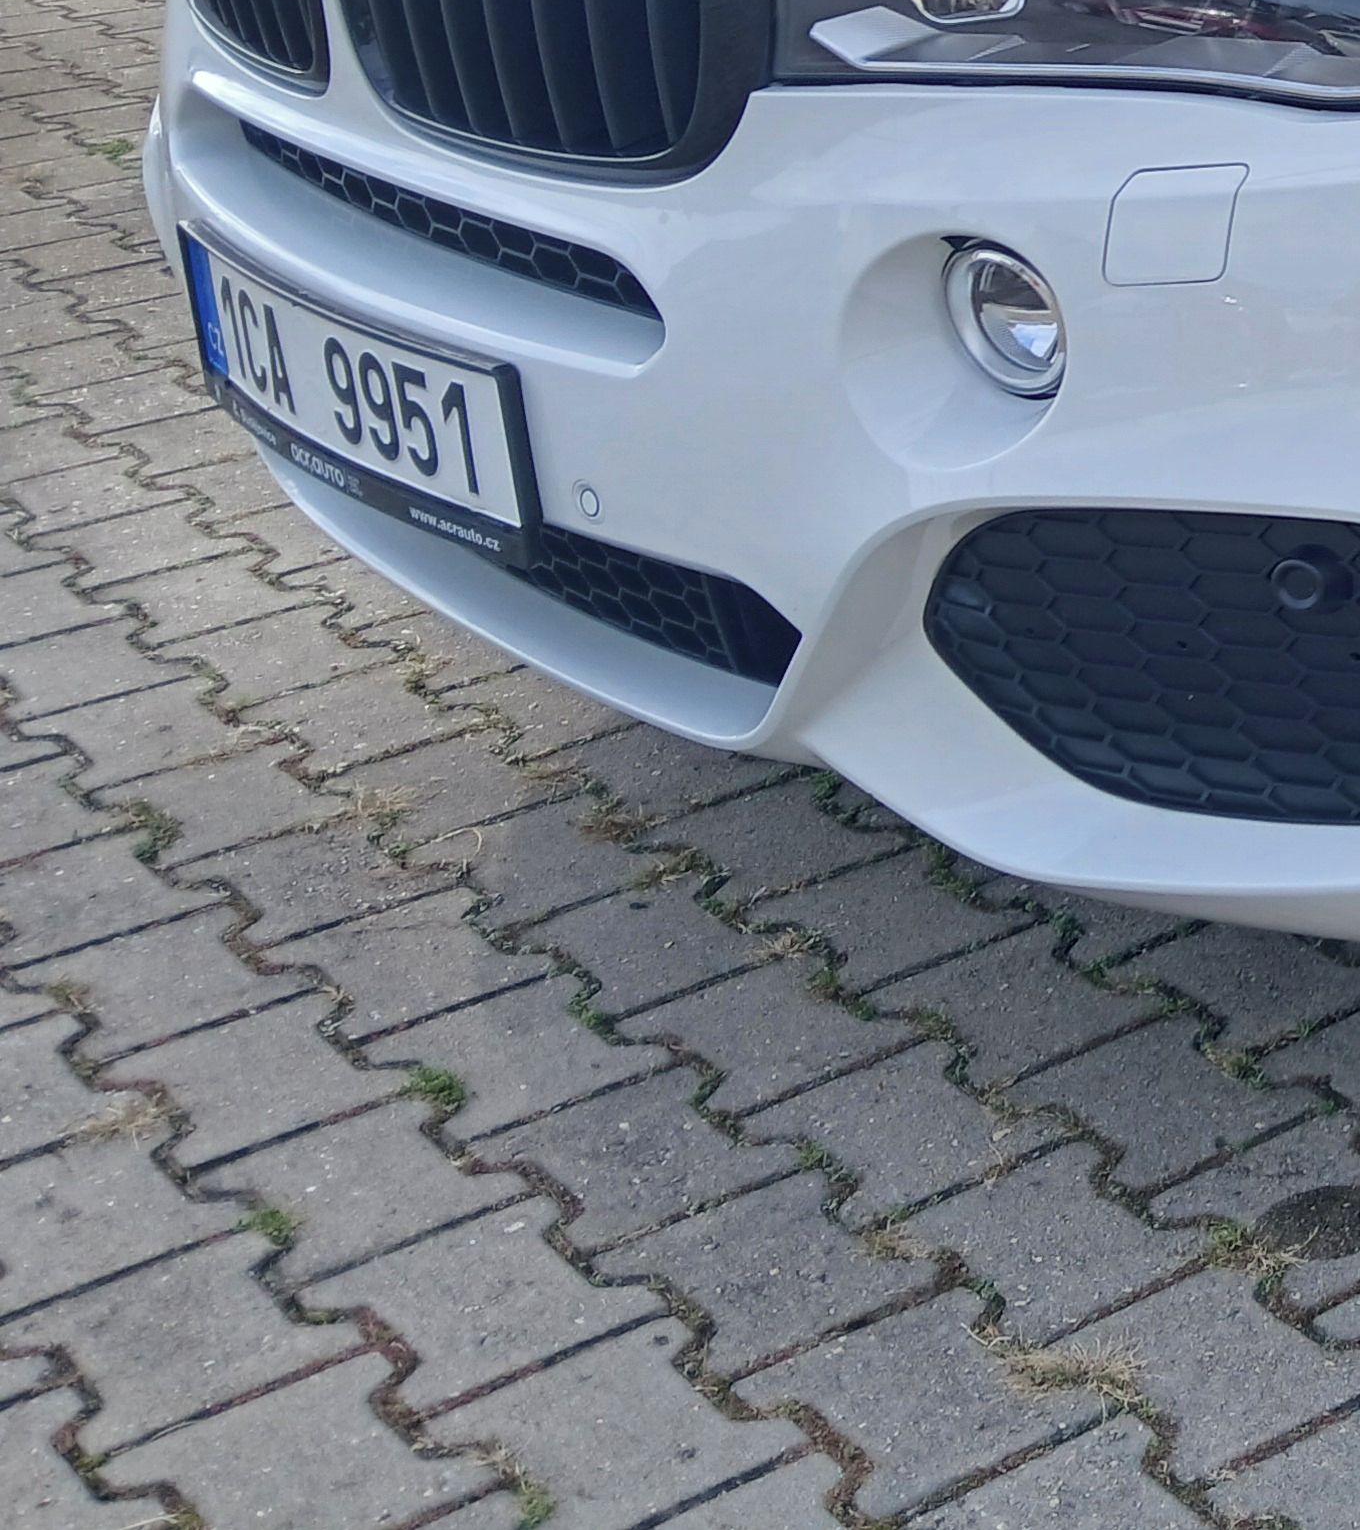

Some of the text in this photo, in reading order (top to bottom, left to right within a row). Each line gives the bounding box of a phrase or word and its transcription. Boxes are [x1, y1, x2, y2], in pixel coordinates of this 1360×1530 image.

[207, 276, 481, 497] CZ 1CA 9951
